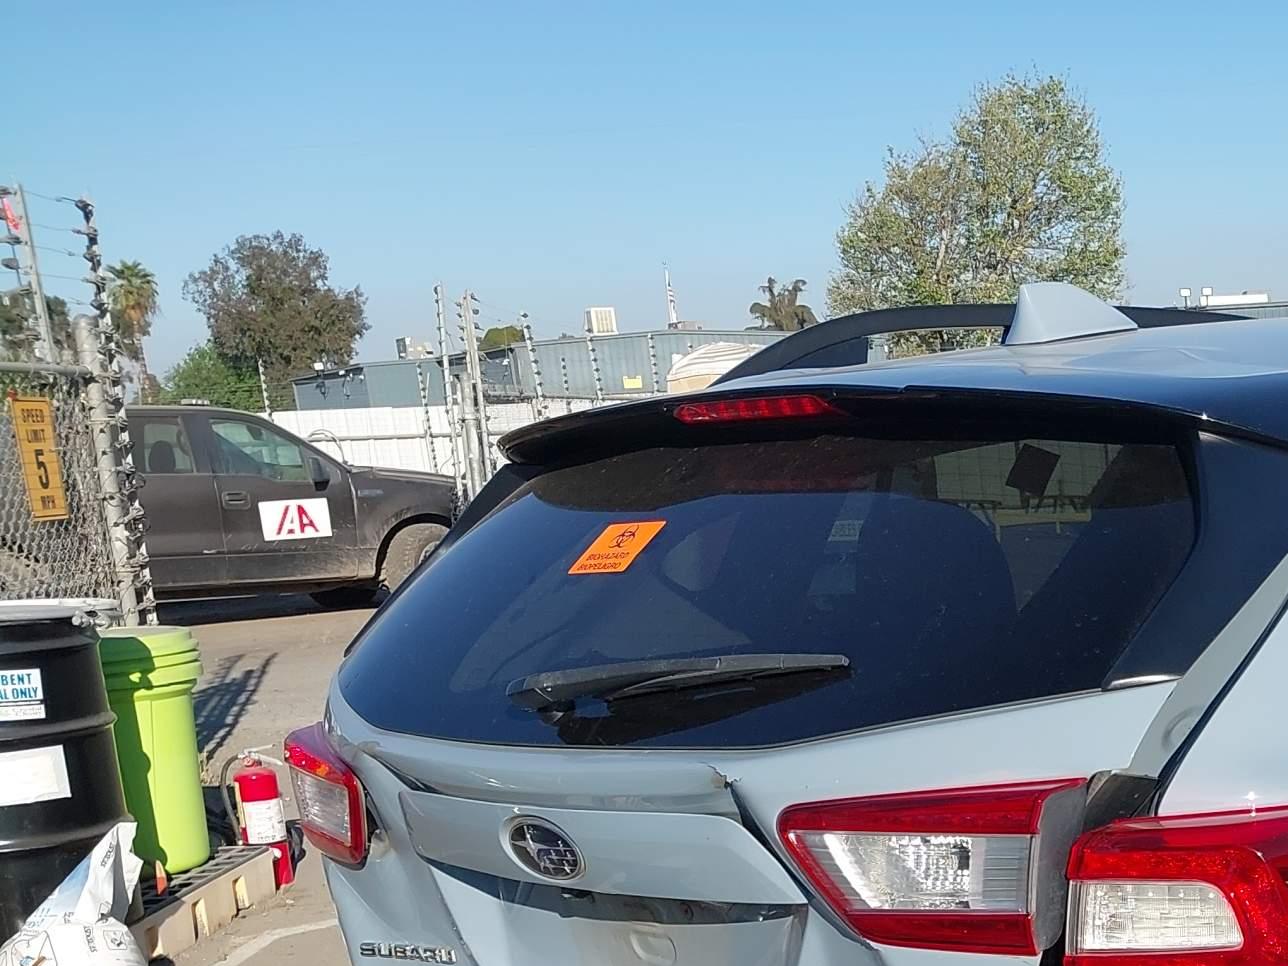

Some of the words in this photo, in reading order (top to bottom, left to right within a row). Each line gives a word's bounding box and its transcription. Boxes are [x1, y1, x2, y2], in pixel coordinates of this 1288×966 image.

[20, 408, 45, 423] SPEED
[25, 428, 46, 443] LIMIT
[34, 448, 50, 490] 5
[40, 495, 57, 510] MPH
[586, 551, 630, 561] BIOHAZARD
[576, 562, 622, 572] BIOPELIGRO
[12, 687, 38, 700] ONLY
[359, 942, 458, 965] SUBARU
